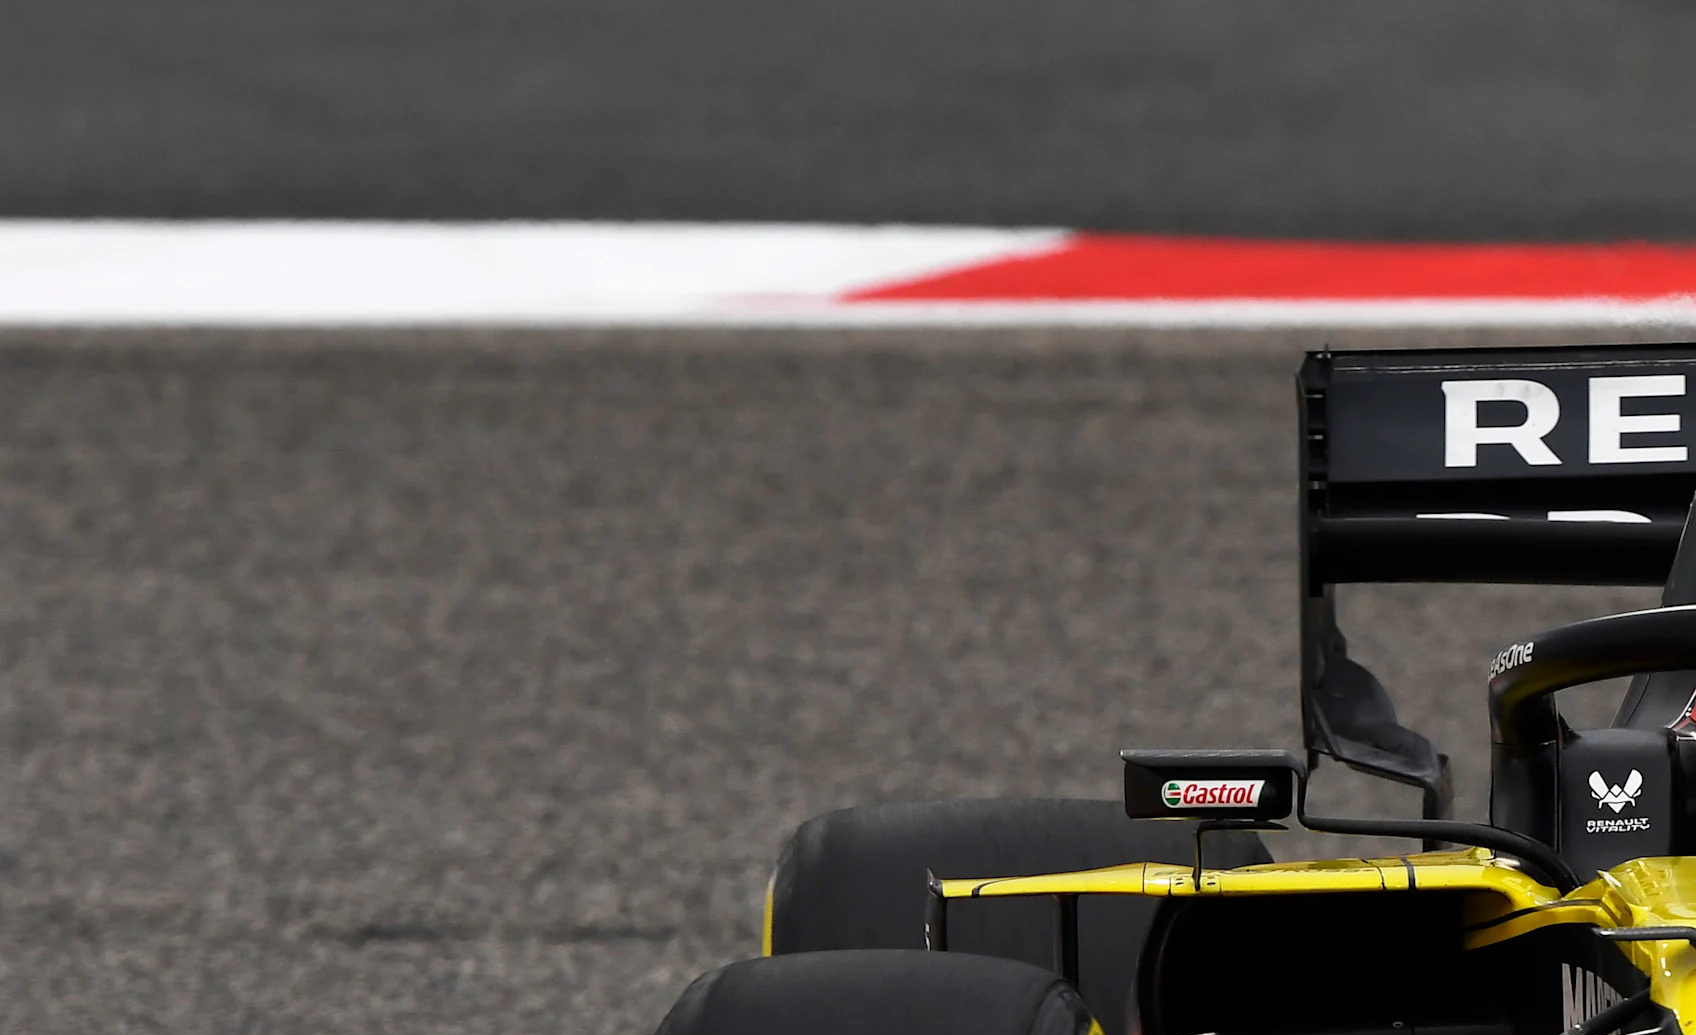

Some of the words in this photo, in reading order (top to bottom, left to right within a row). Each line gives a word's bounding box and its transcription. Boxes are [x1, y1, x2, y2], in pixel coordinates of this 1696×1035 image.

[1183, 783, 1255, 805] Castrol
[1586, 817, 1650, 827] RENAULT
[1585, 823, 1651, 833] VITALITY
